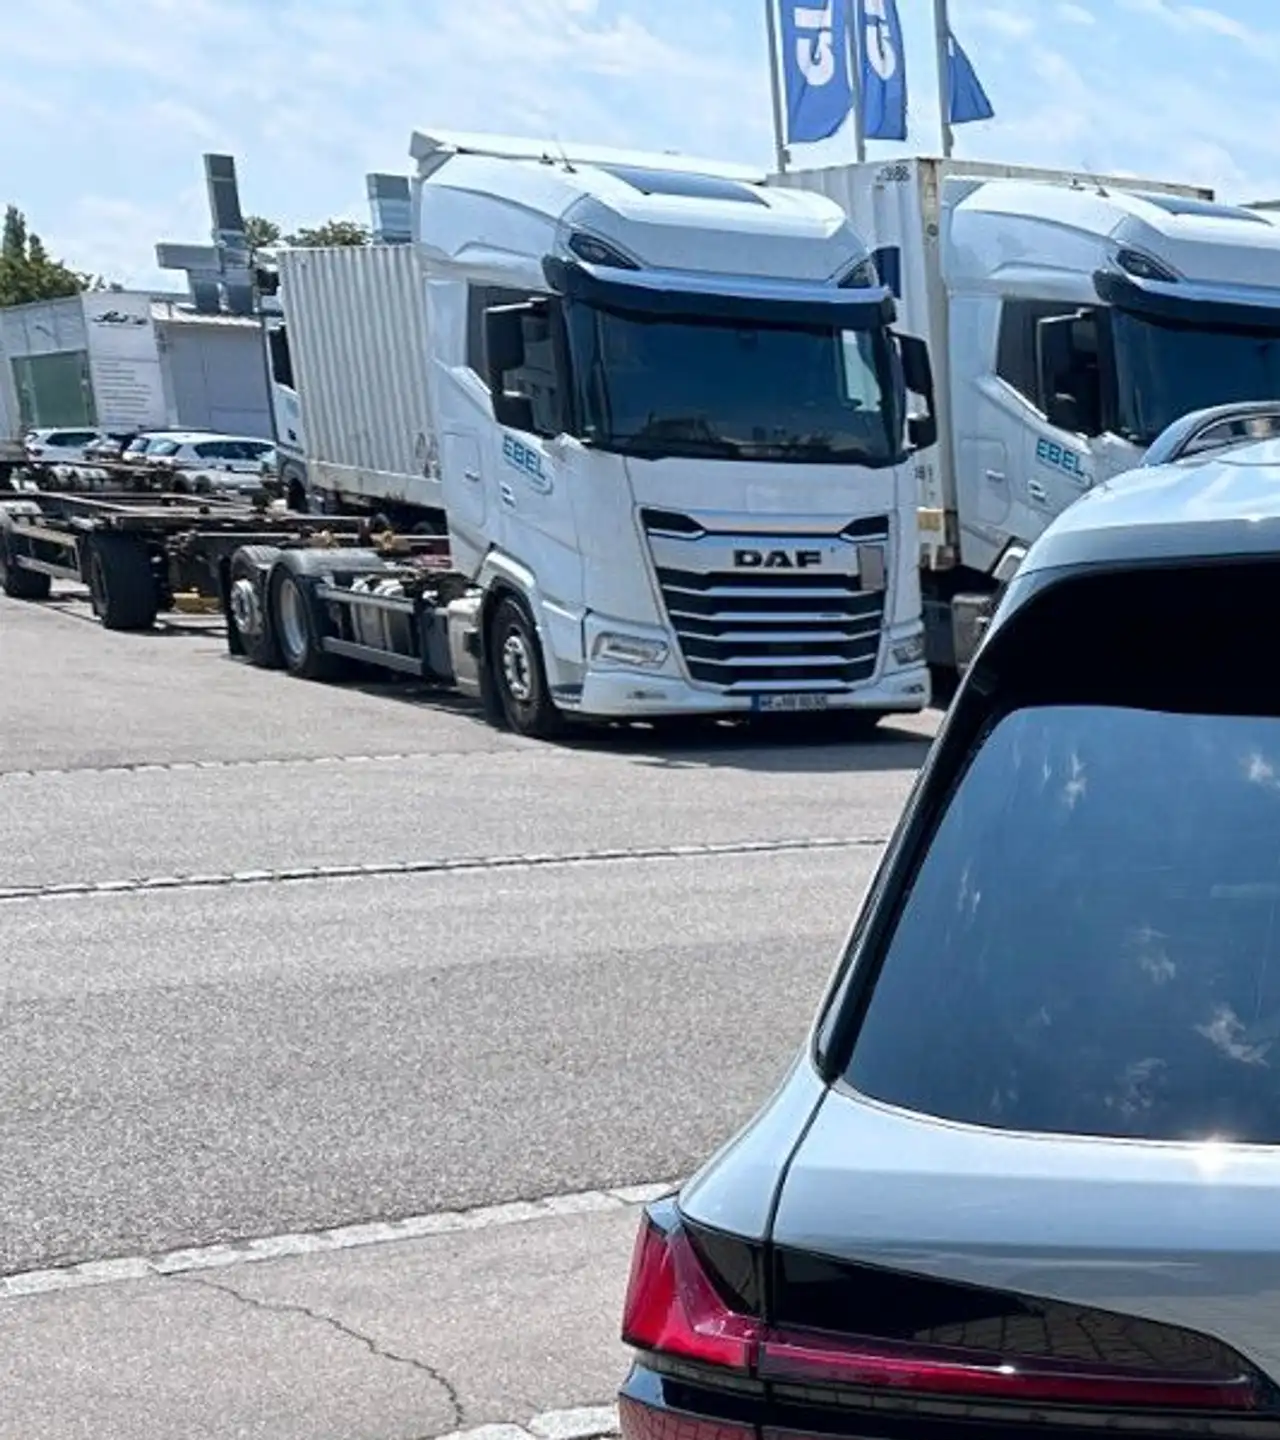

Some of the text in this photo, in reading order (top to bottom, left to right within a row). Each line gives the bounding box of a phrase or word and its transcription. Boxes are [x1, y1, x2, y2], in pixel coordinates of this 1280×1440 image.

[502, 433, 546, 481] EBEL
[1037, 437, 1085, 477] EBEL
[733, 549, 822, 568] DAF
